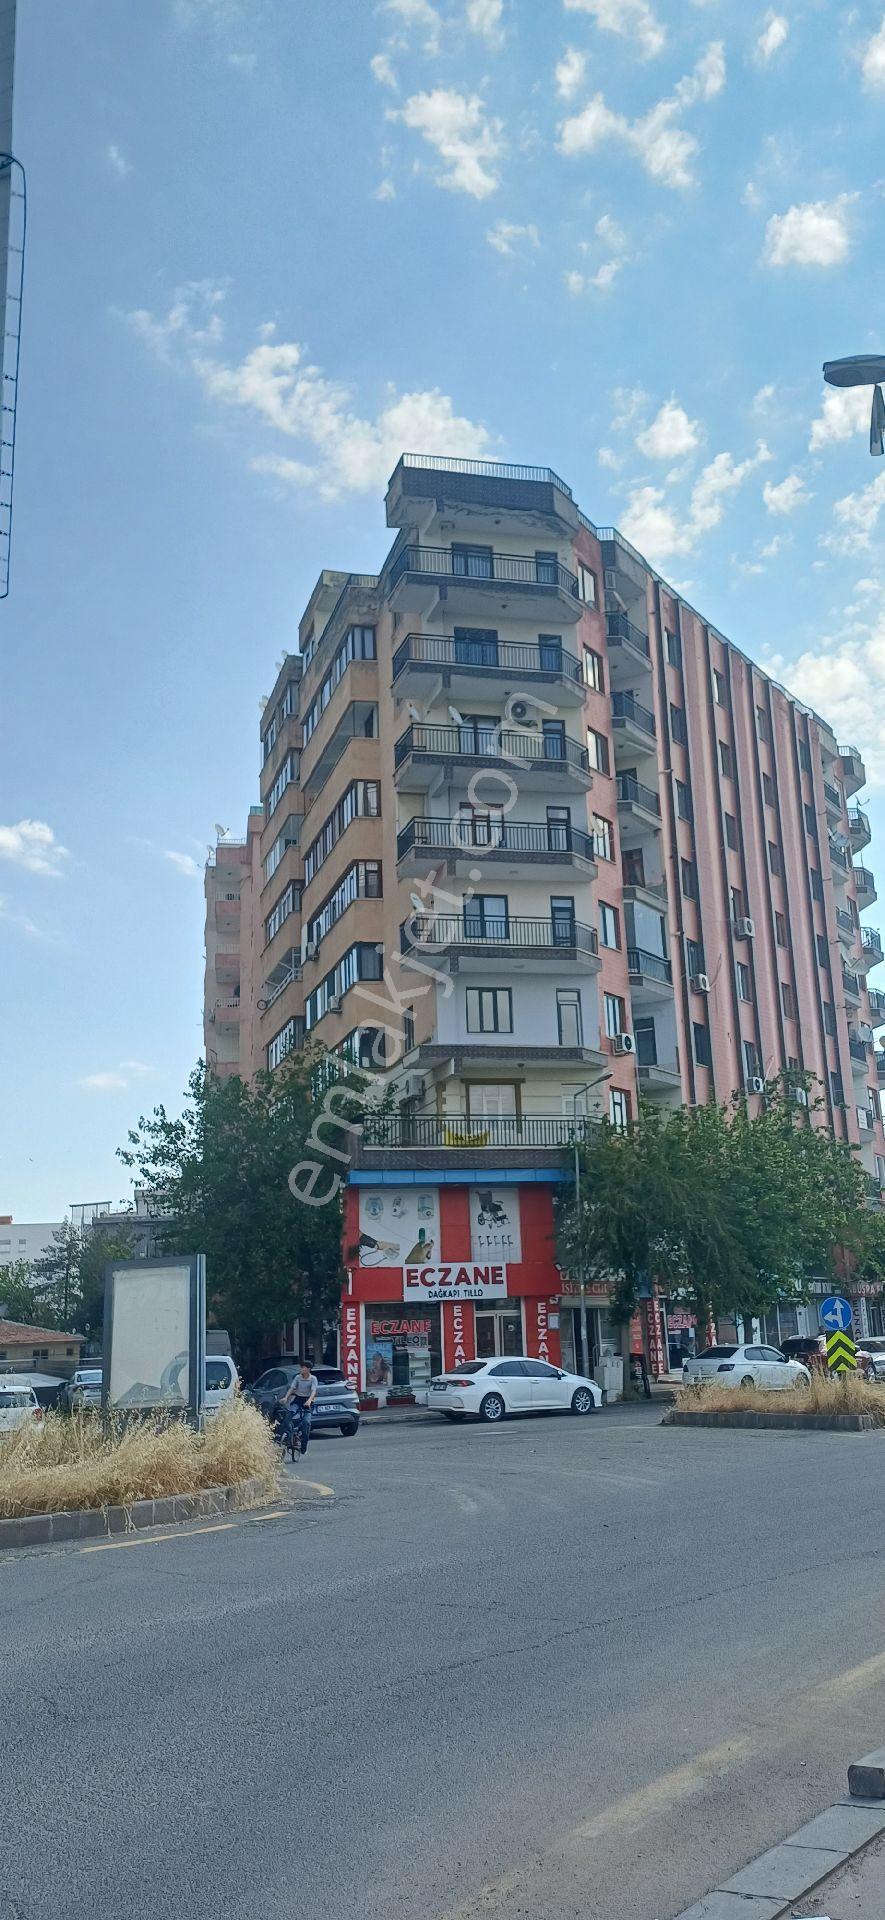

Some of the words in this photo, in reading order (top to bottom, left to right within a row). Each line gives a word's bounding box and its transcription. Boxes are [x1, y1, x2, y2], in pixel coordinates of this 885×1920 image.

[406, 1266, 504, 1288] ECZANE
[371, 1319, 431, 1335] ECZANE
[453, 1305, 466, 1367] ECZAN
[537, 1302, 549, 1363] ECZAN
[647, 1301, 658, 1374] ECZANE
[654, 1300, 664, 1374] ECZANE
